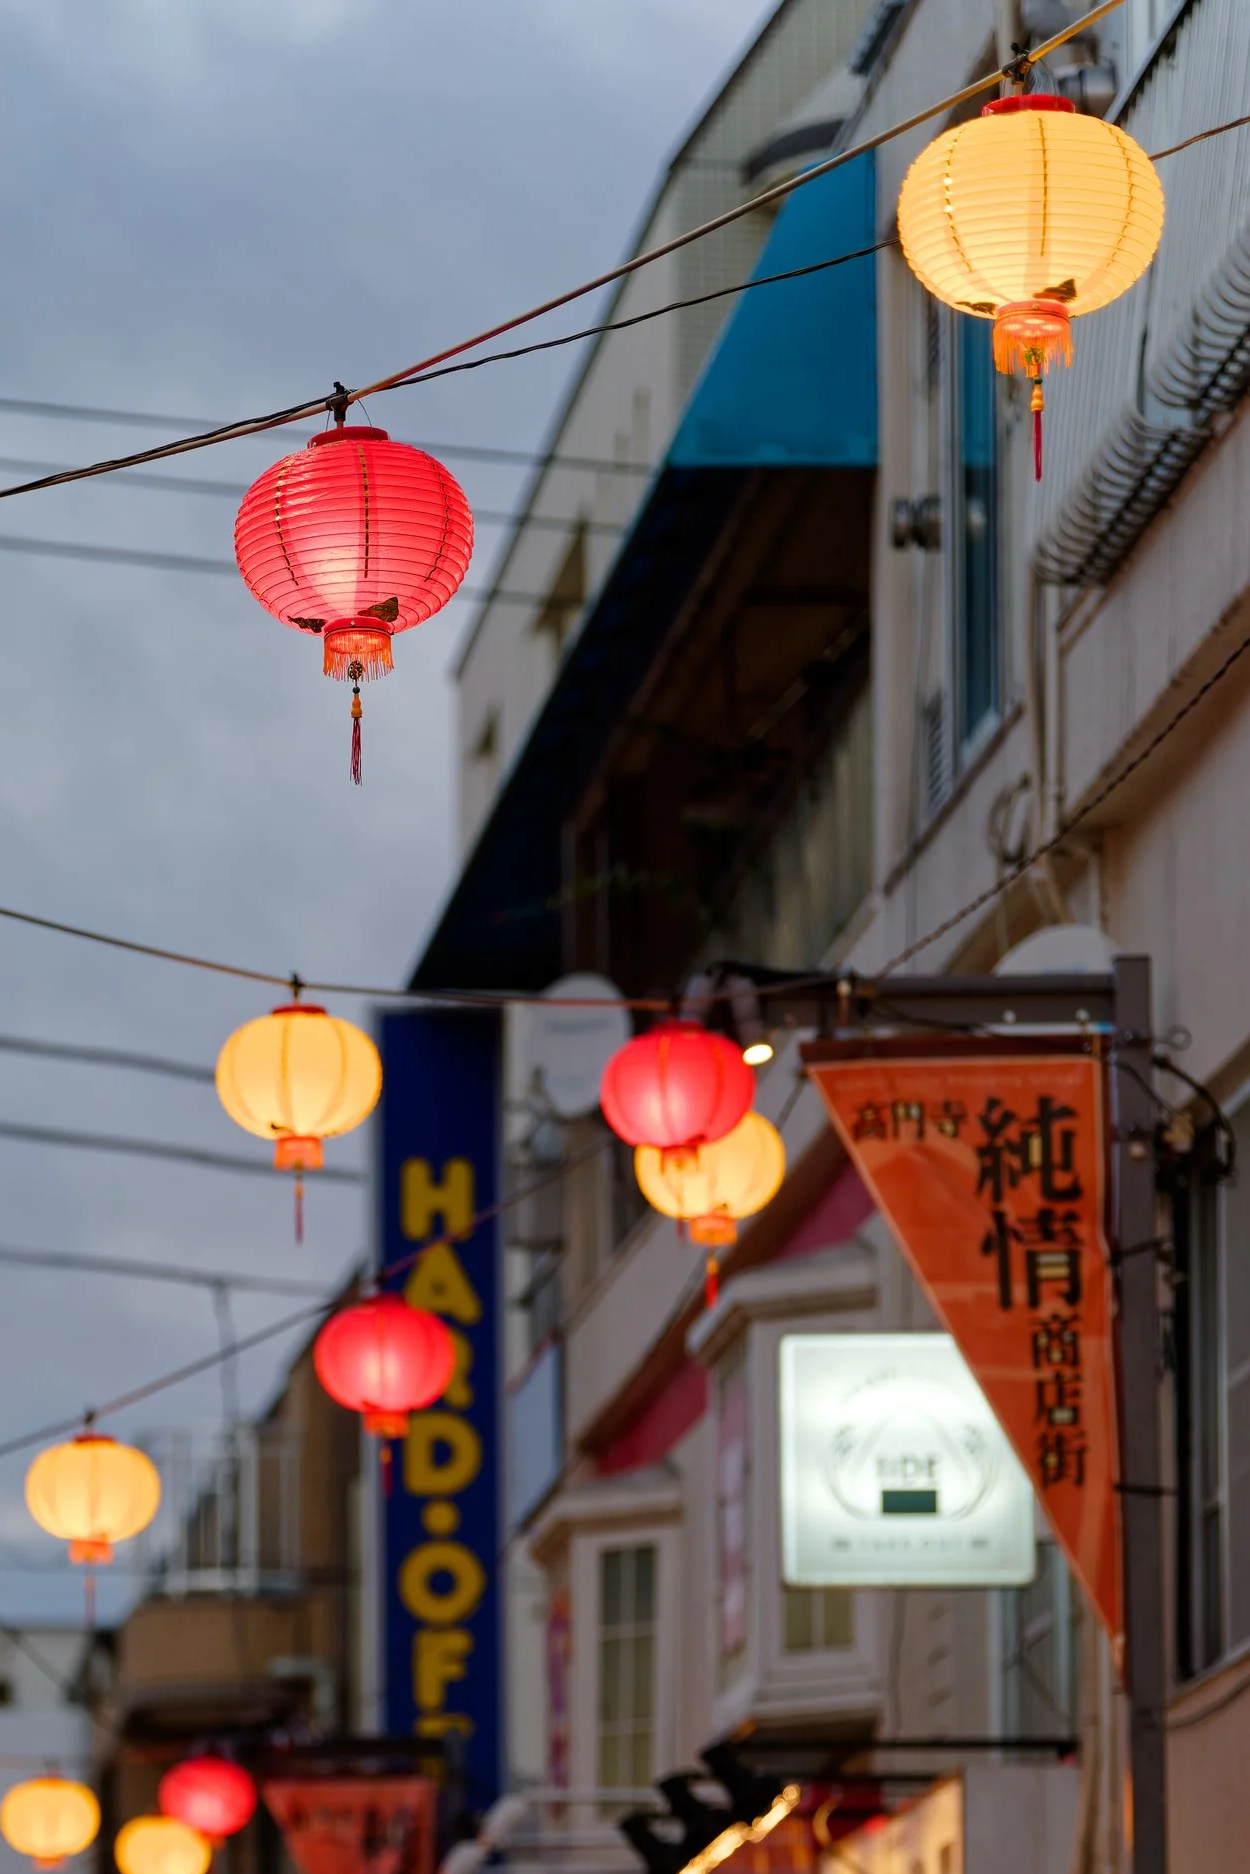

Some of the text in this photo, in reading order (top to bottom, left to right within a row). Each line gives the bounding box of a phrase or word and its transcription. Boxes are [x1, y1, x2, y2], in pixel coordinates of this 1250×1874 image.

[976, 1095, 1088, 1488] 純情商店街
